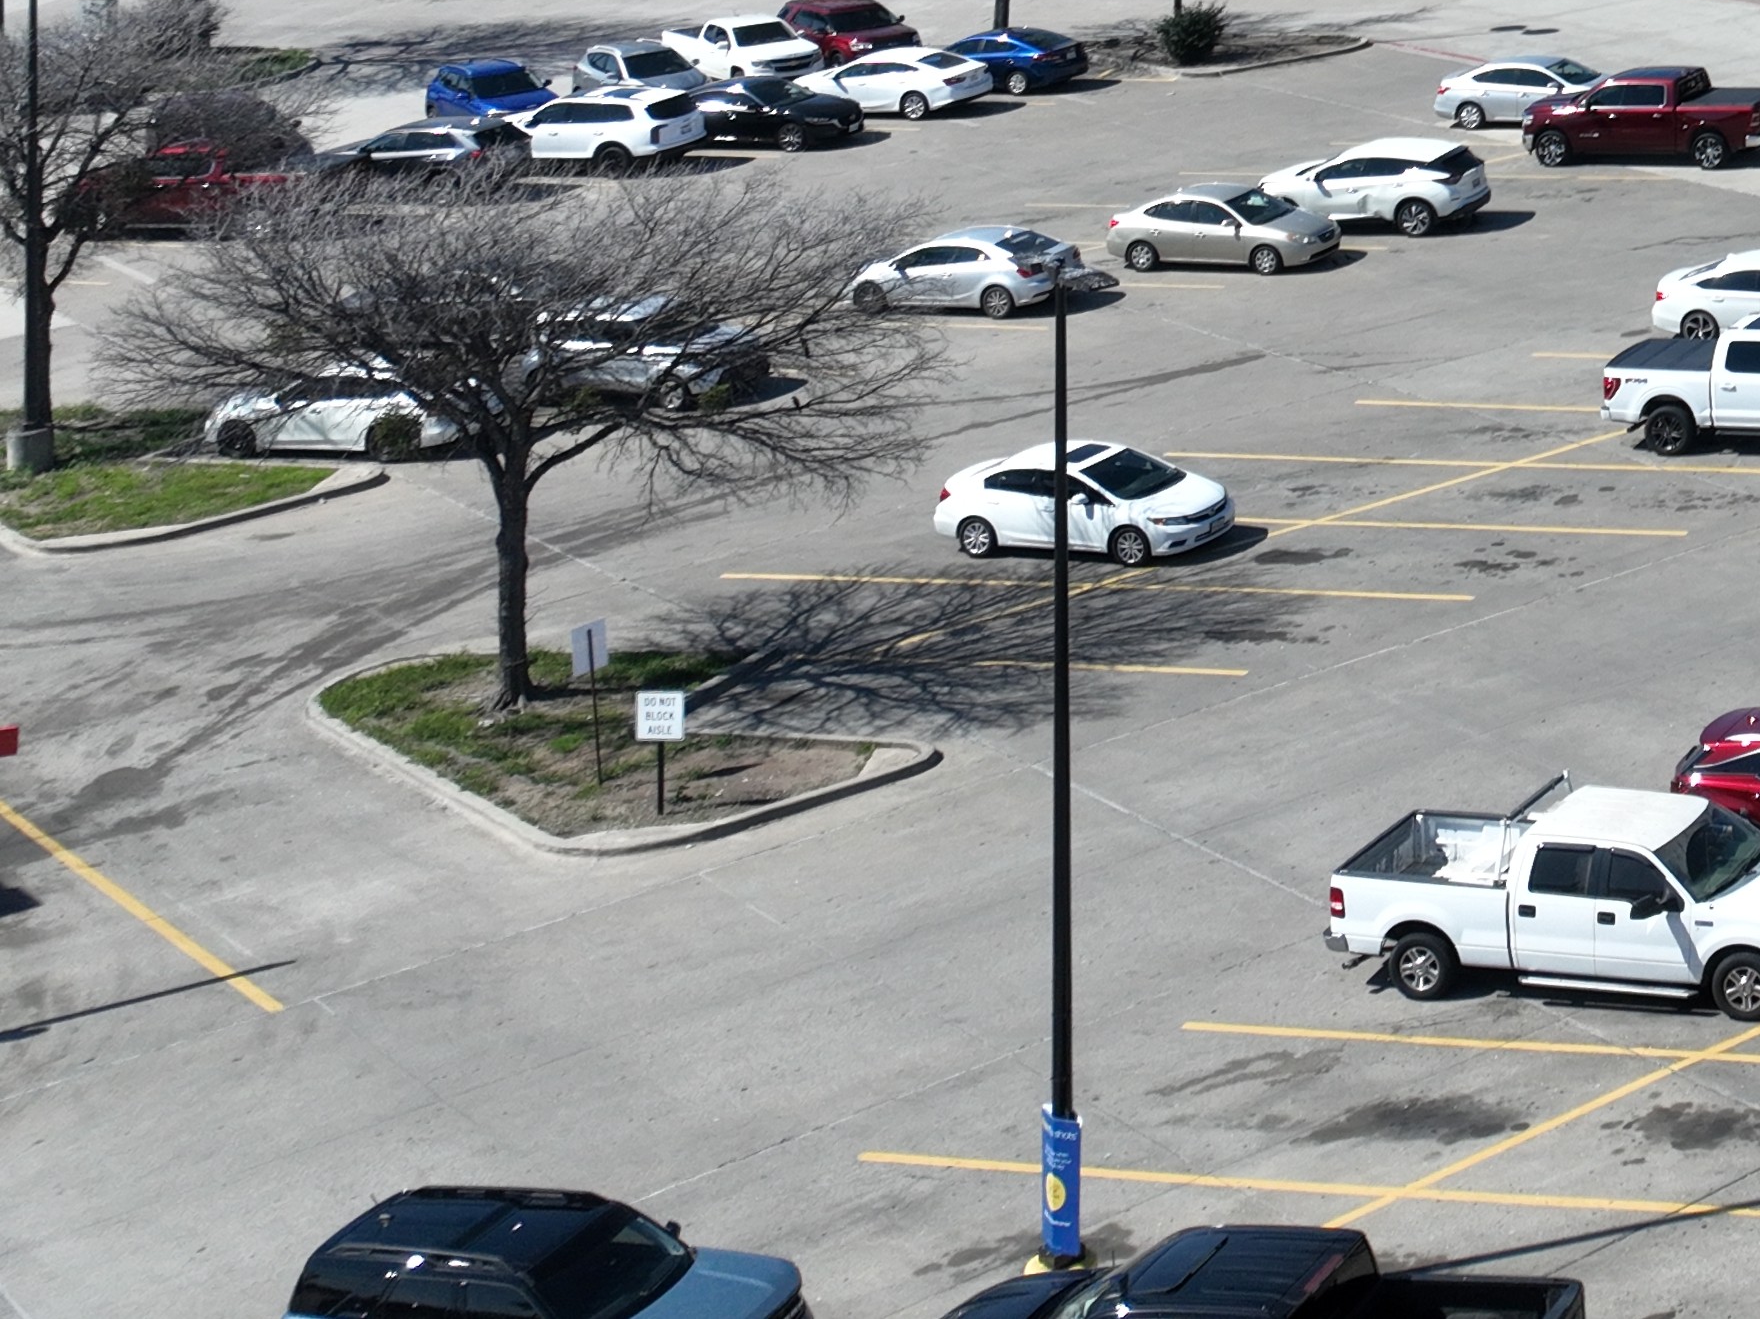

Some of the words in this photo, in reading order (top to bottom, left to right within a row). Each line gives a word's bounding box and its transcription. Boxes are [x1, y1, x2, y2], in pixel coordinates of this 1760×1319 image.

[644, 697, 657, 707] DO
[659, 697, 676, 707] NOT
[645, 711, 675, 721] BLOCK
[647, 724, 672, 735] AISLE
